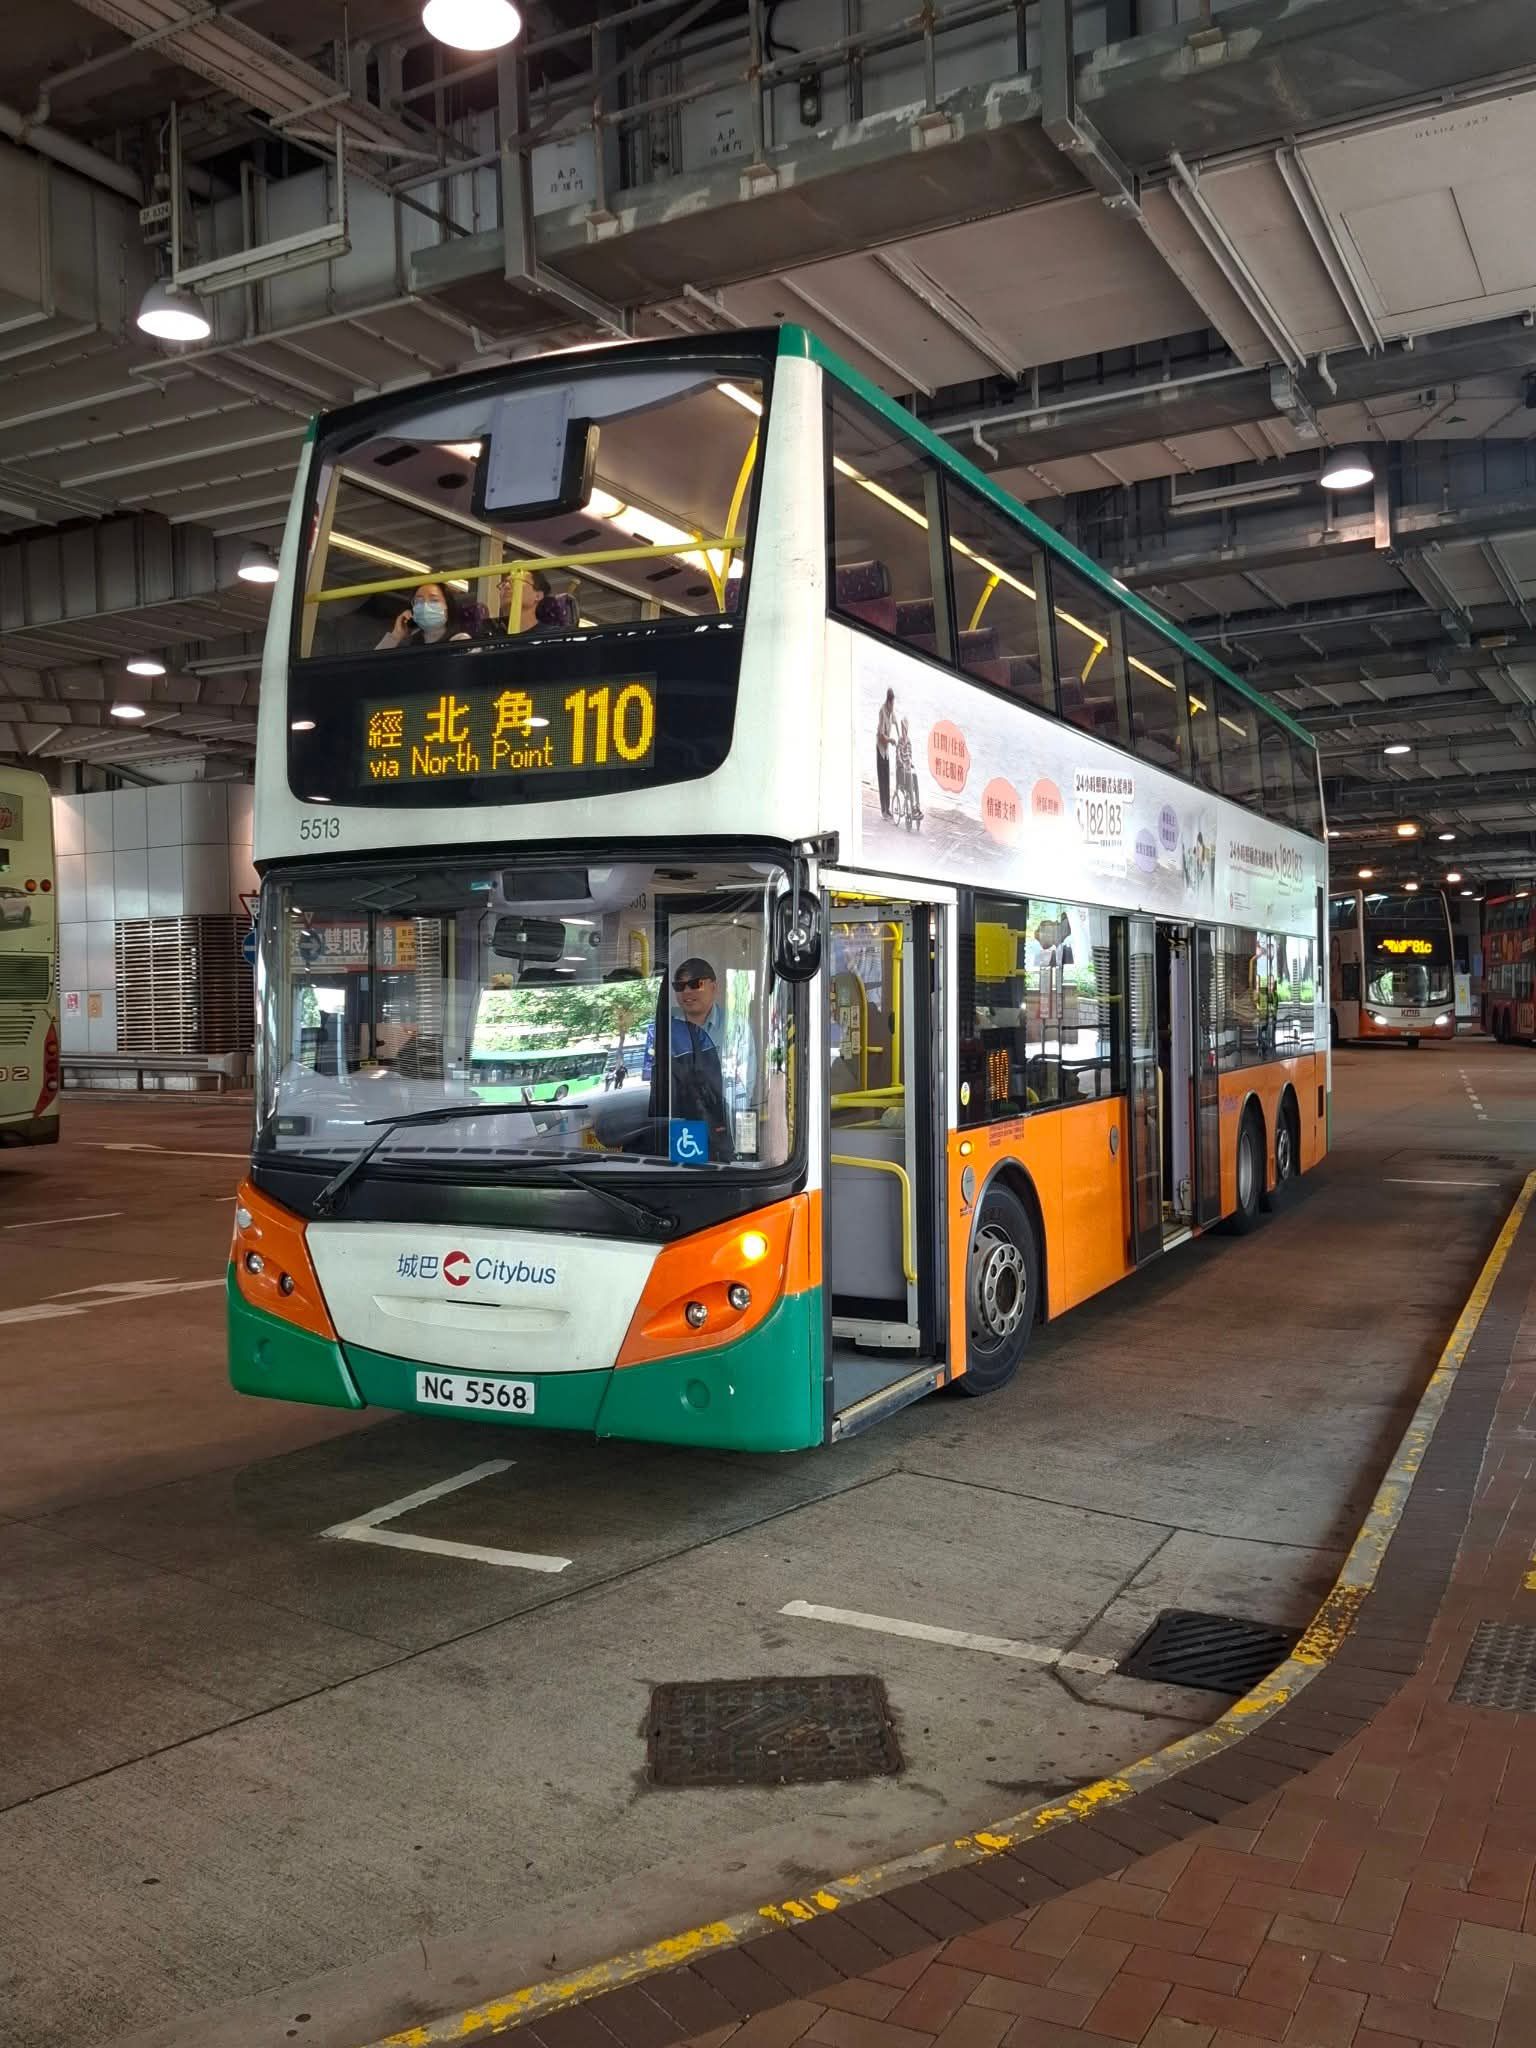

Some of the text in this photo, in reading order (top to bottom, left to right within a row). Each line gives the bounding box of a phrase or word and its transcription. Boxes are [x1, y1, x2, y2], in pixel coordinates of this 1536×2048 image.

[565, 684, 654, 764] 110
[370, 736, 553, 778] via North Point
[300, 817, 340, 840] 5513
[396, 1253, 439, 1279] 城巴
[475, 1257, 557, 1285] Citybus
[424, 1375, 528, 1409] NG 5568
